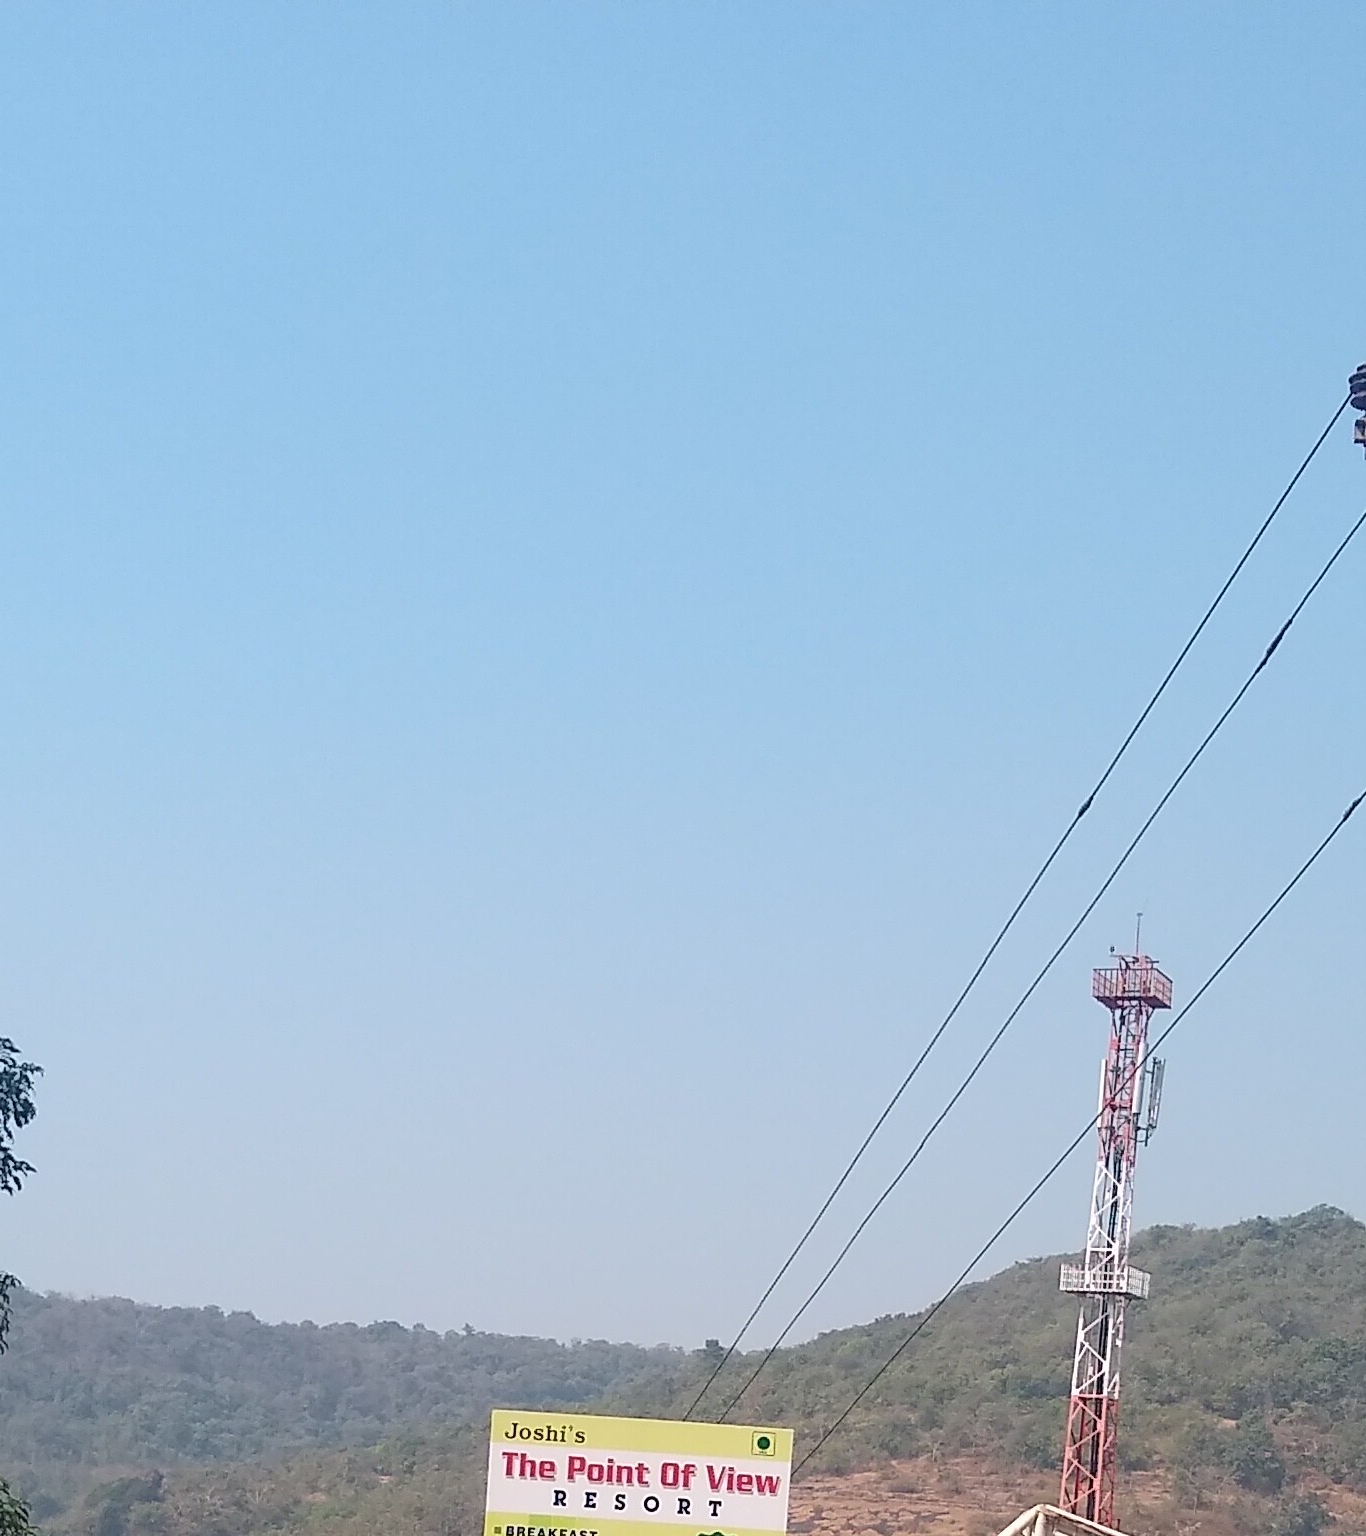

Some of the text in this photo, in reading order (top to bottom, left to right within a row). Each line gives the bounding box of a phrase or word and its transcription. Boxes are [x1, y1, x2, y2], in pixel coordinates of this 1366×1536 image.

[505, 1422, 586, 1444] Joshi's
[502, 1452, 782, 1495] The Point Of View
[553, 1490, 723, 1517] RESORT
